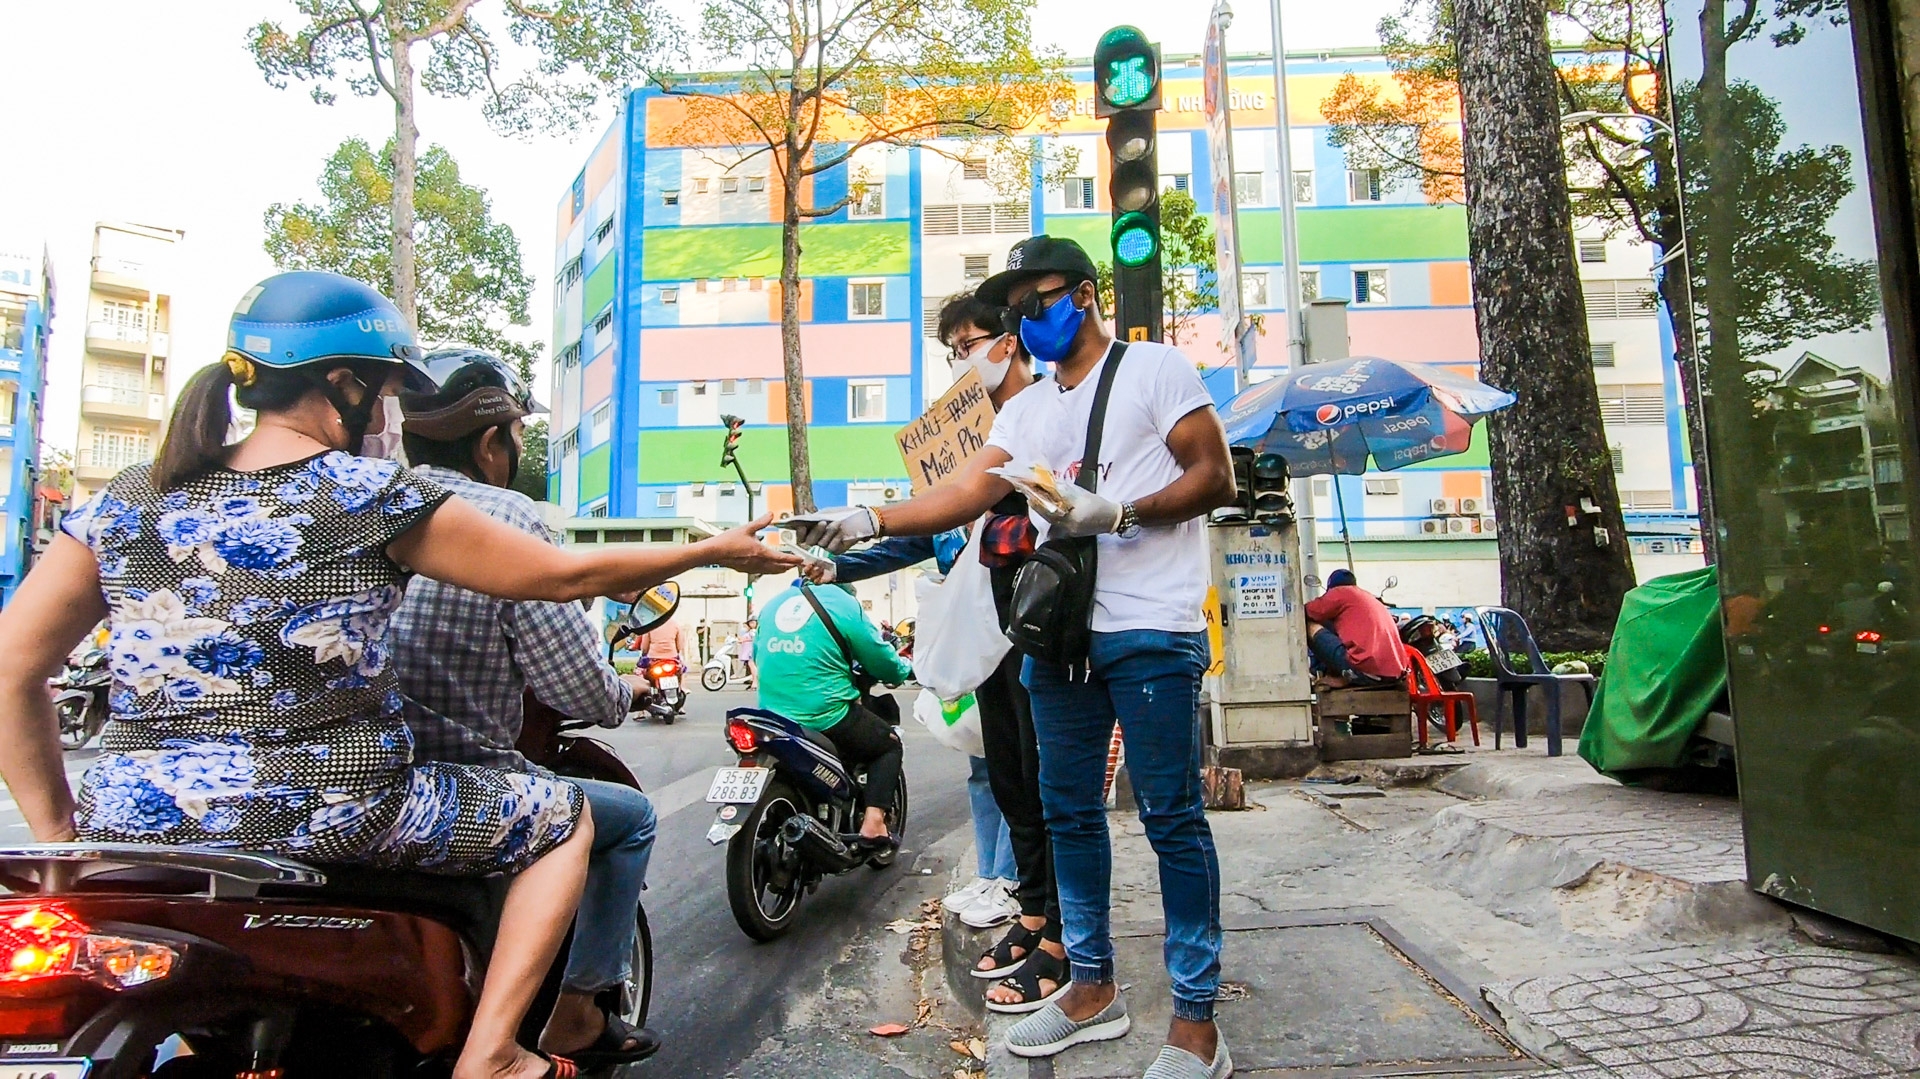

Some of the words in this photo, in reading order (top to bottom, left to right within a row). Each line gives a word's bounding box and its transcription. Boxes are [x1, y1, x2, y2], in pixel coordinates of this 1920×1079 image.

[1344, 396, 1394, 418] pepsi
[767, 636, 806, 655] Grab
[722, 771, 759, 785] 35-B2
[811, 762, 841, 789] YAMAHA
[711, 786, 758, 800] 286.83
[243, 913, 374, 929] VISION
[7, 1043, 58, 1054] HONDA
